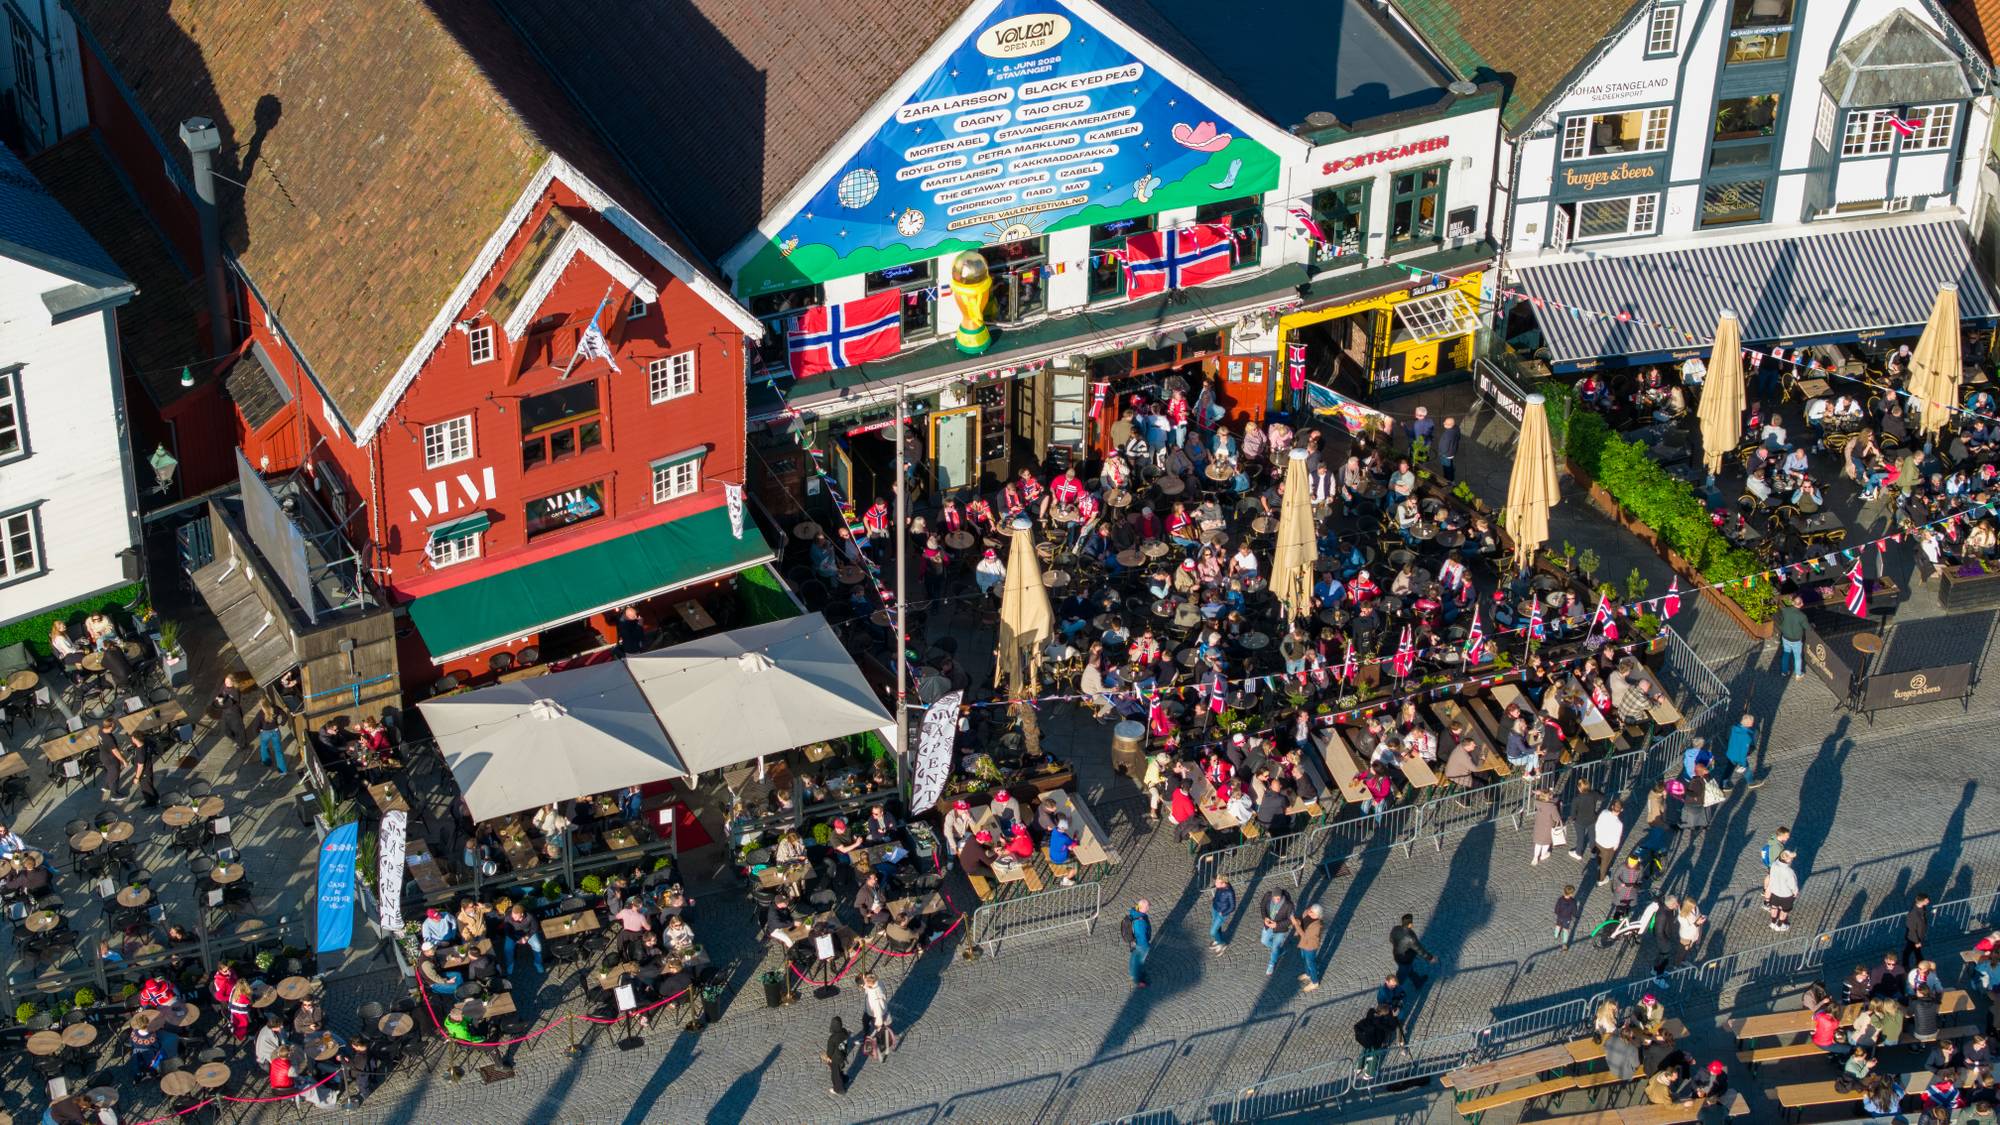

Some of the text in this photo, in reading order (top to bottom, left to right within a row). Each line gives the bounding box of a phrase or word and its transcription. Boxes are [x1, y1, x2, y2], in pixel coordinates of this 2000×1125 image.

[1003, 38, 1046, 52] OPEN AIR
[1013, 60, 1036, 71] JUNI
[1037, 55, 1062, 66] 2026
[996, 65, 1052, 81] STAVANGER
[1025, 68, 1137, 95] BLACK EYED PEAS
[1605, 78, 1669, 93] STANGELAND
[903, 92, 1008, 119] ZARA LARSSON
[1023, 100, 1084, 117] TAIO CRUZ
[960, 113, 1004, 128] DAGNY
[999, 109, 1131, 140] STAVANGERKAMERATENE
[1089, 125, 1139, 141] KAMELEN
[909, 137, 985, 158] MORTEN ABEL
[977, 137, 1075, 161] PETRA MARKLUND
[1322, 135, 1450, 175] SPORTSCAFEEN
[1013, 147, 1114, 169] KAKKMADDAFAKKA
[901, 159, 962, 178] ROYEL OTIS
[925, 167, 999, 188] MARIT LARSEN
[1060, 166, 1098, 178] IZABELL
[1563, 162, 1654, 190] burger & beers
[940, 174, 1045, 201] THE GETAWAY PEOPLE
[1026, 187, 1053, 198] RABO
[1065, 182, 1086, 192] MAY
[951, 195, 1013, 213] FORDREKORD
[998, 196, 1085, 218] VAULENFESTIVAL.NO
